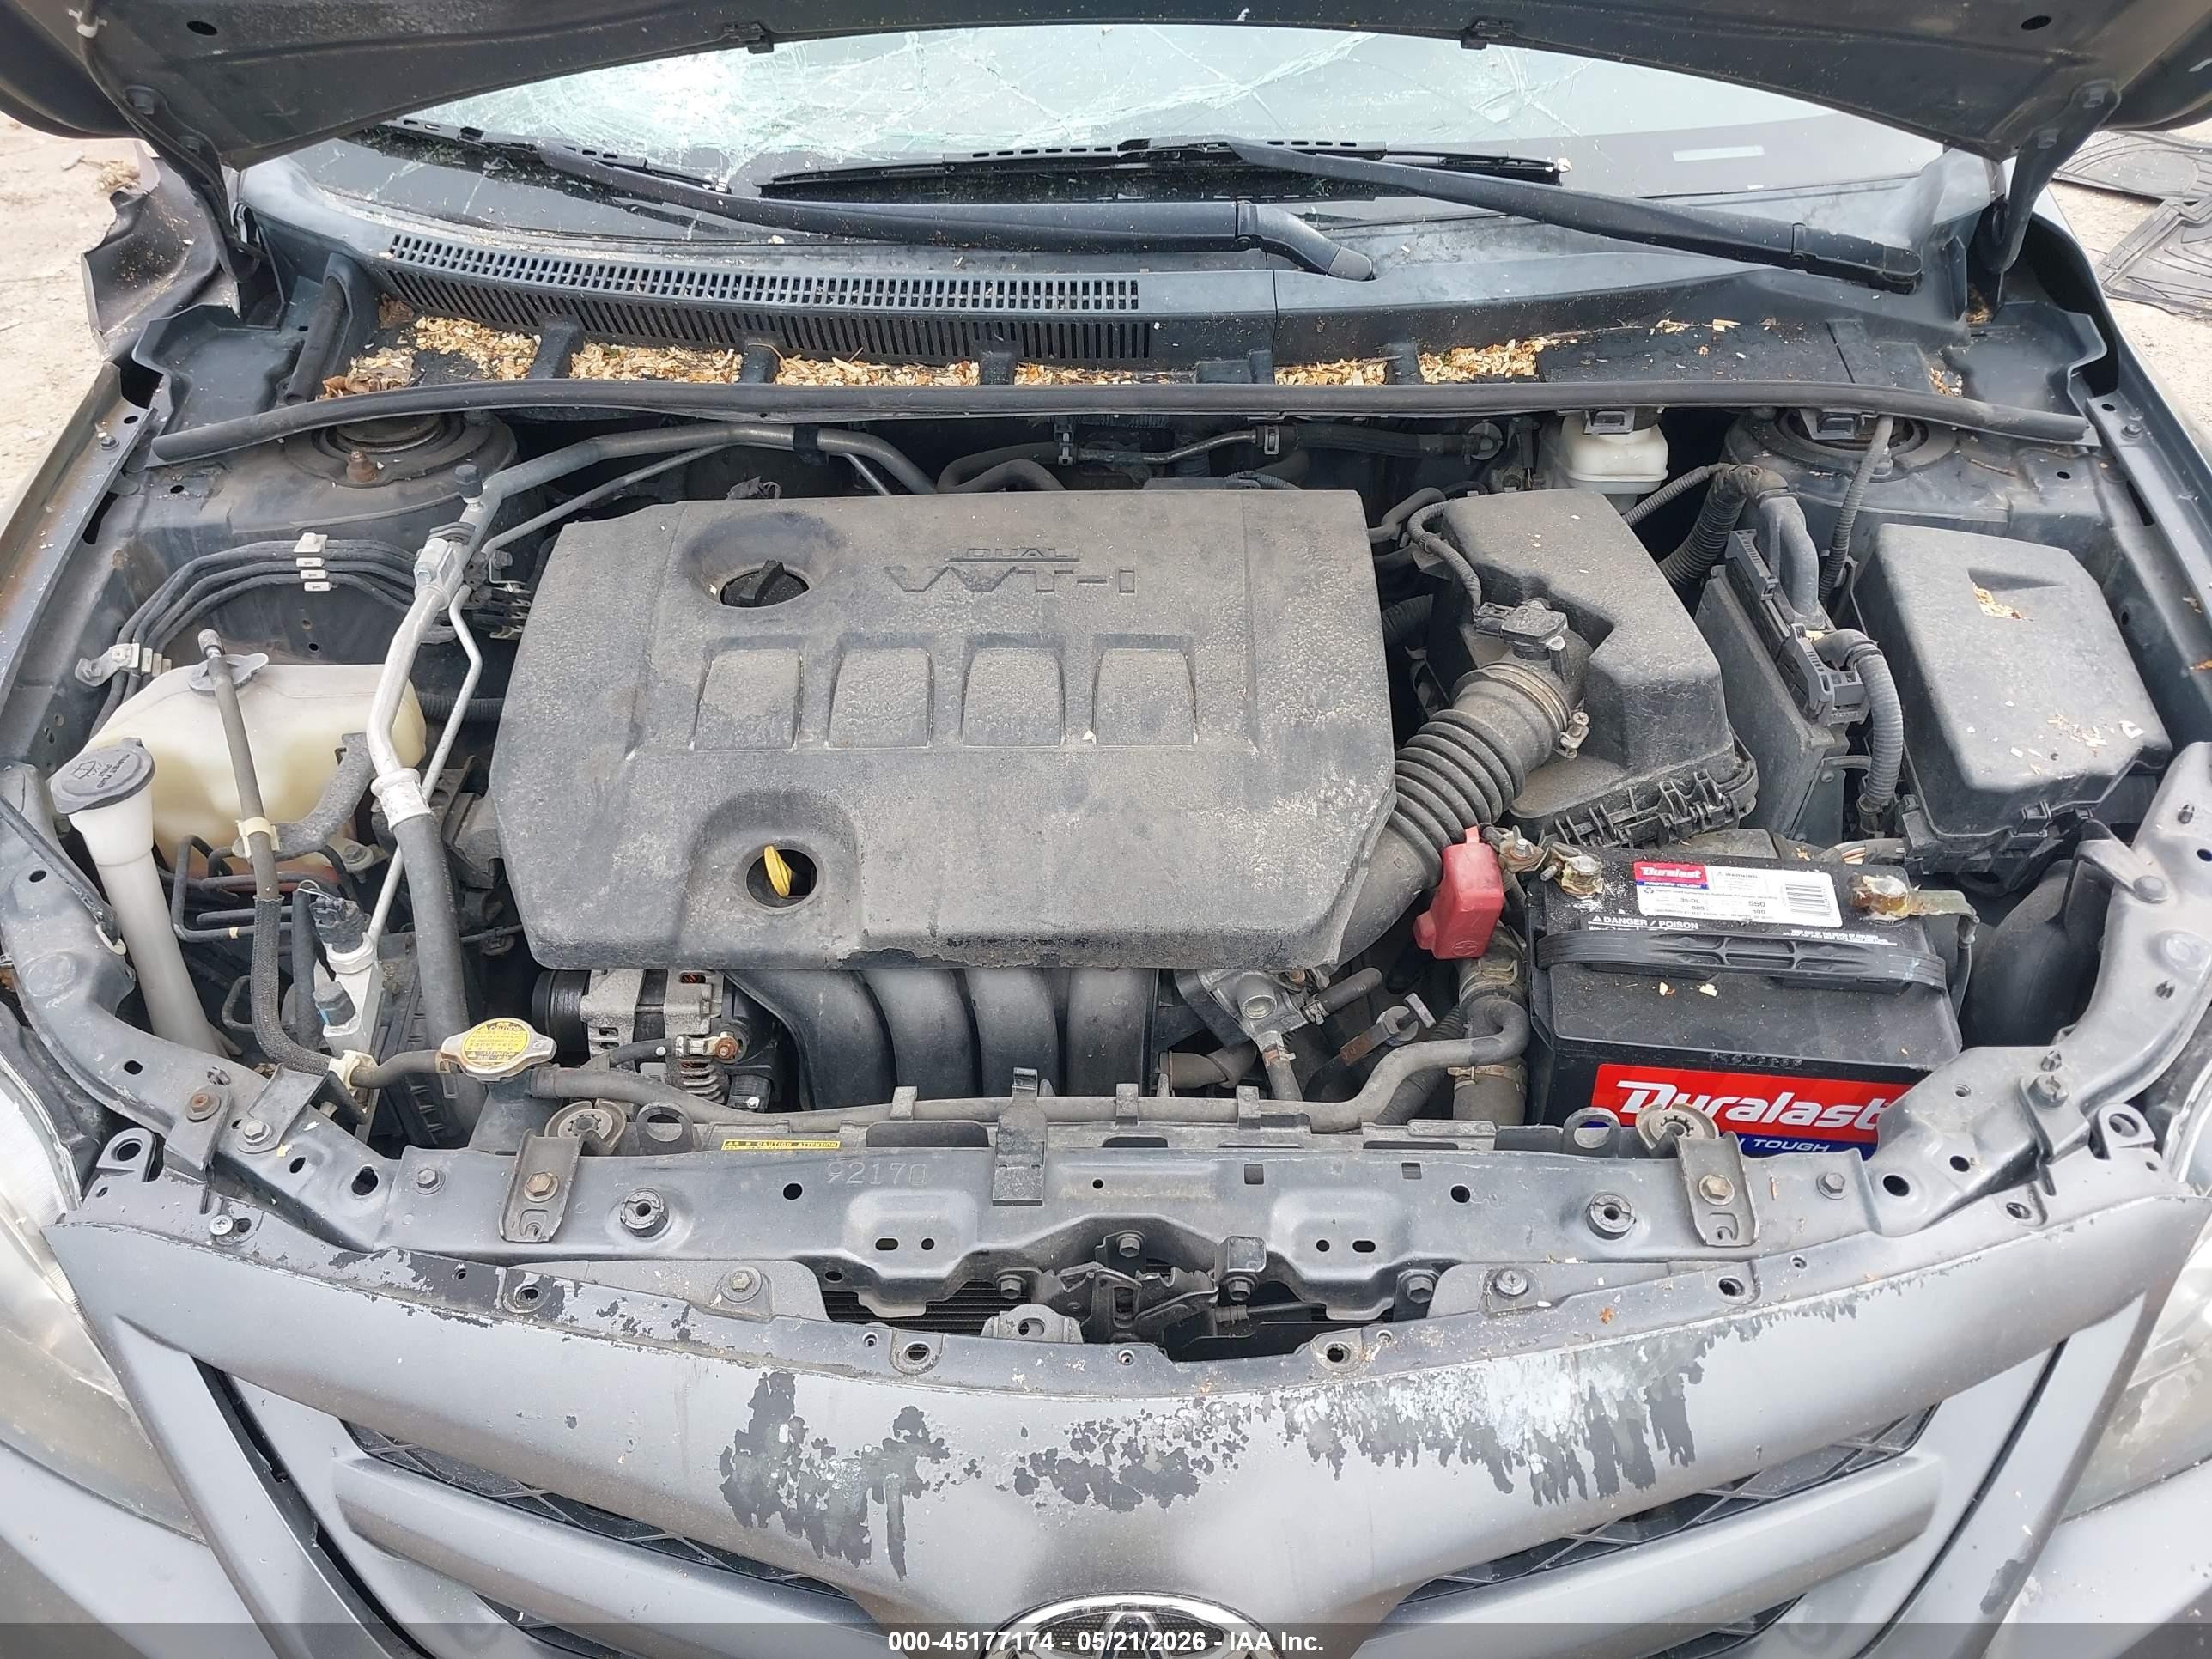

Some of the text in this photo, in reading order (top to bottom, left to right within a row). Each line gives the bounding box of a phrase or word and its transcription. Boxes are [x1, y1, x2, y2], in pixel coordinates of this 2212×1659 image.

[967, 547, 1080, 559] DUAL
[1640, 866, 1702, 879] Duralast
[1603, 915, 1648, 927] DANGER
[1658, 920, 1699, 930] POISON
[1616, 1080, 1891, 1131] Duralast
[1753, 1139, 1831, 1152] TOUGH
[827, 1161, 927, 1185] 92170
